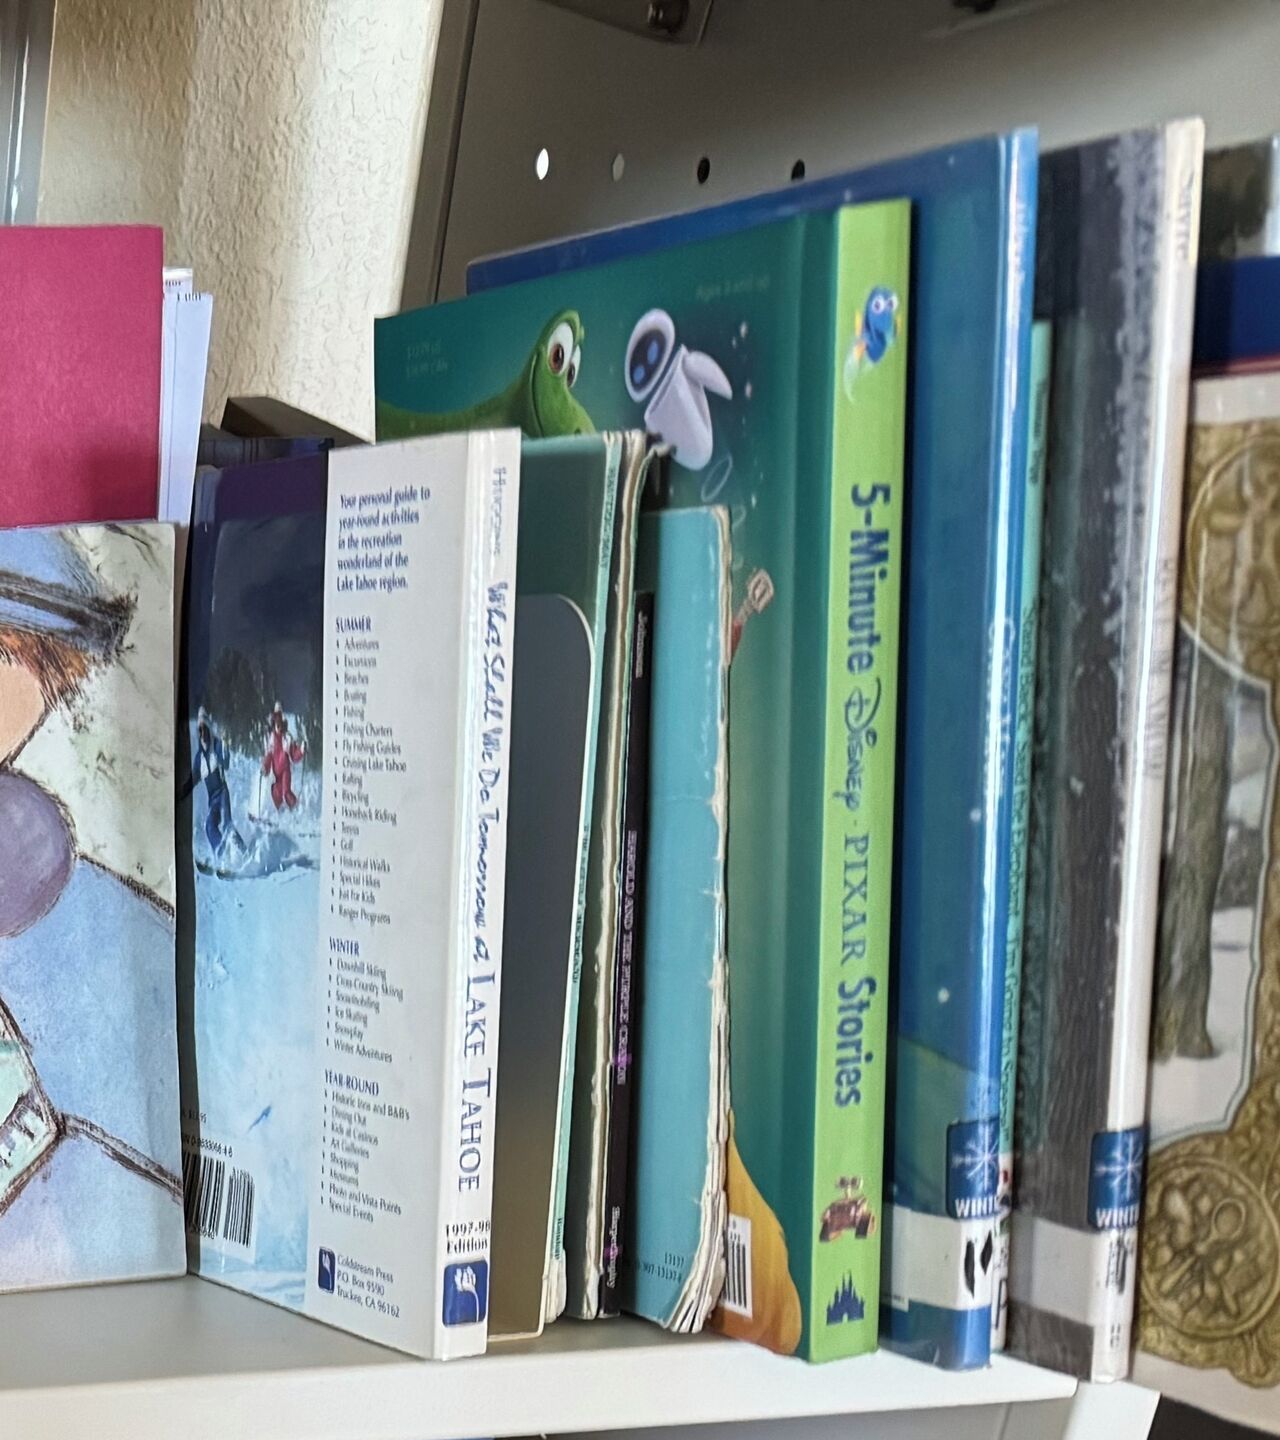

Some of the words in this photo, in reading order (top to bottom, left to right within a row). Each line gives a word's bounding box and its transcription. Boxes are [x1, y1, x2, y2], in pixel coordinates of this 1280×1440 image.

[358, 487, 393, 511] personal
[393, 485, 418, 509] guide
[420, 486, 431, 501] to
[381, 507, 420, 527] activities
[361, 532, 403, 550] recreation
[395, 551, 409, 567] the
[848, 482, 892, 675] 5-Minute
[335, 615, 372, 633] SUMMER
[831, 677, 882, 812] Disney
[838, 832, 871, 967] PIXAR
[329, 936, 360, 957] WINTER
[834, 974, 878, 1108] Stories
[372, 1101, 387, 1116] and
[458, 1066, 491, 1193] TAHOE
[379, 1198, 402, 1216] Points
[446, 1237, 489, 1255] Edition
[351, 1274, 366, 1290] Box
[375, 1267, 394, 1284] Press
[364, 1295, 377, 1310] CA
[376, 1300, 401, 1319] 96162
